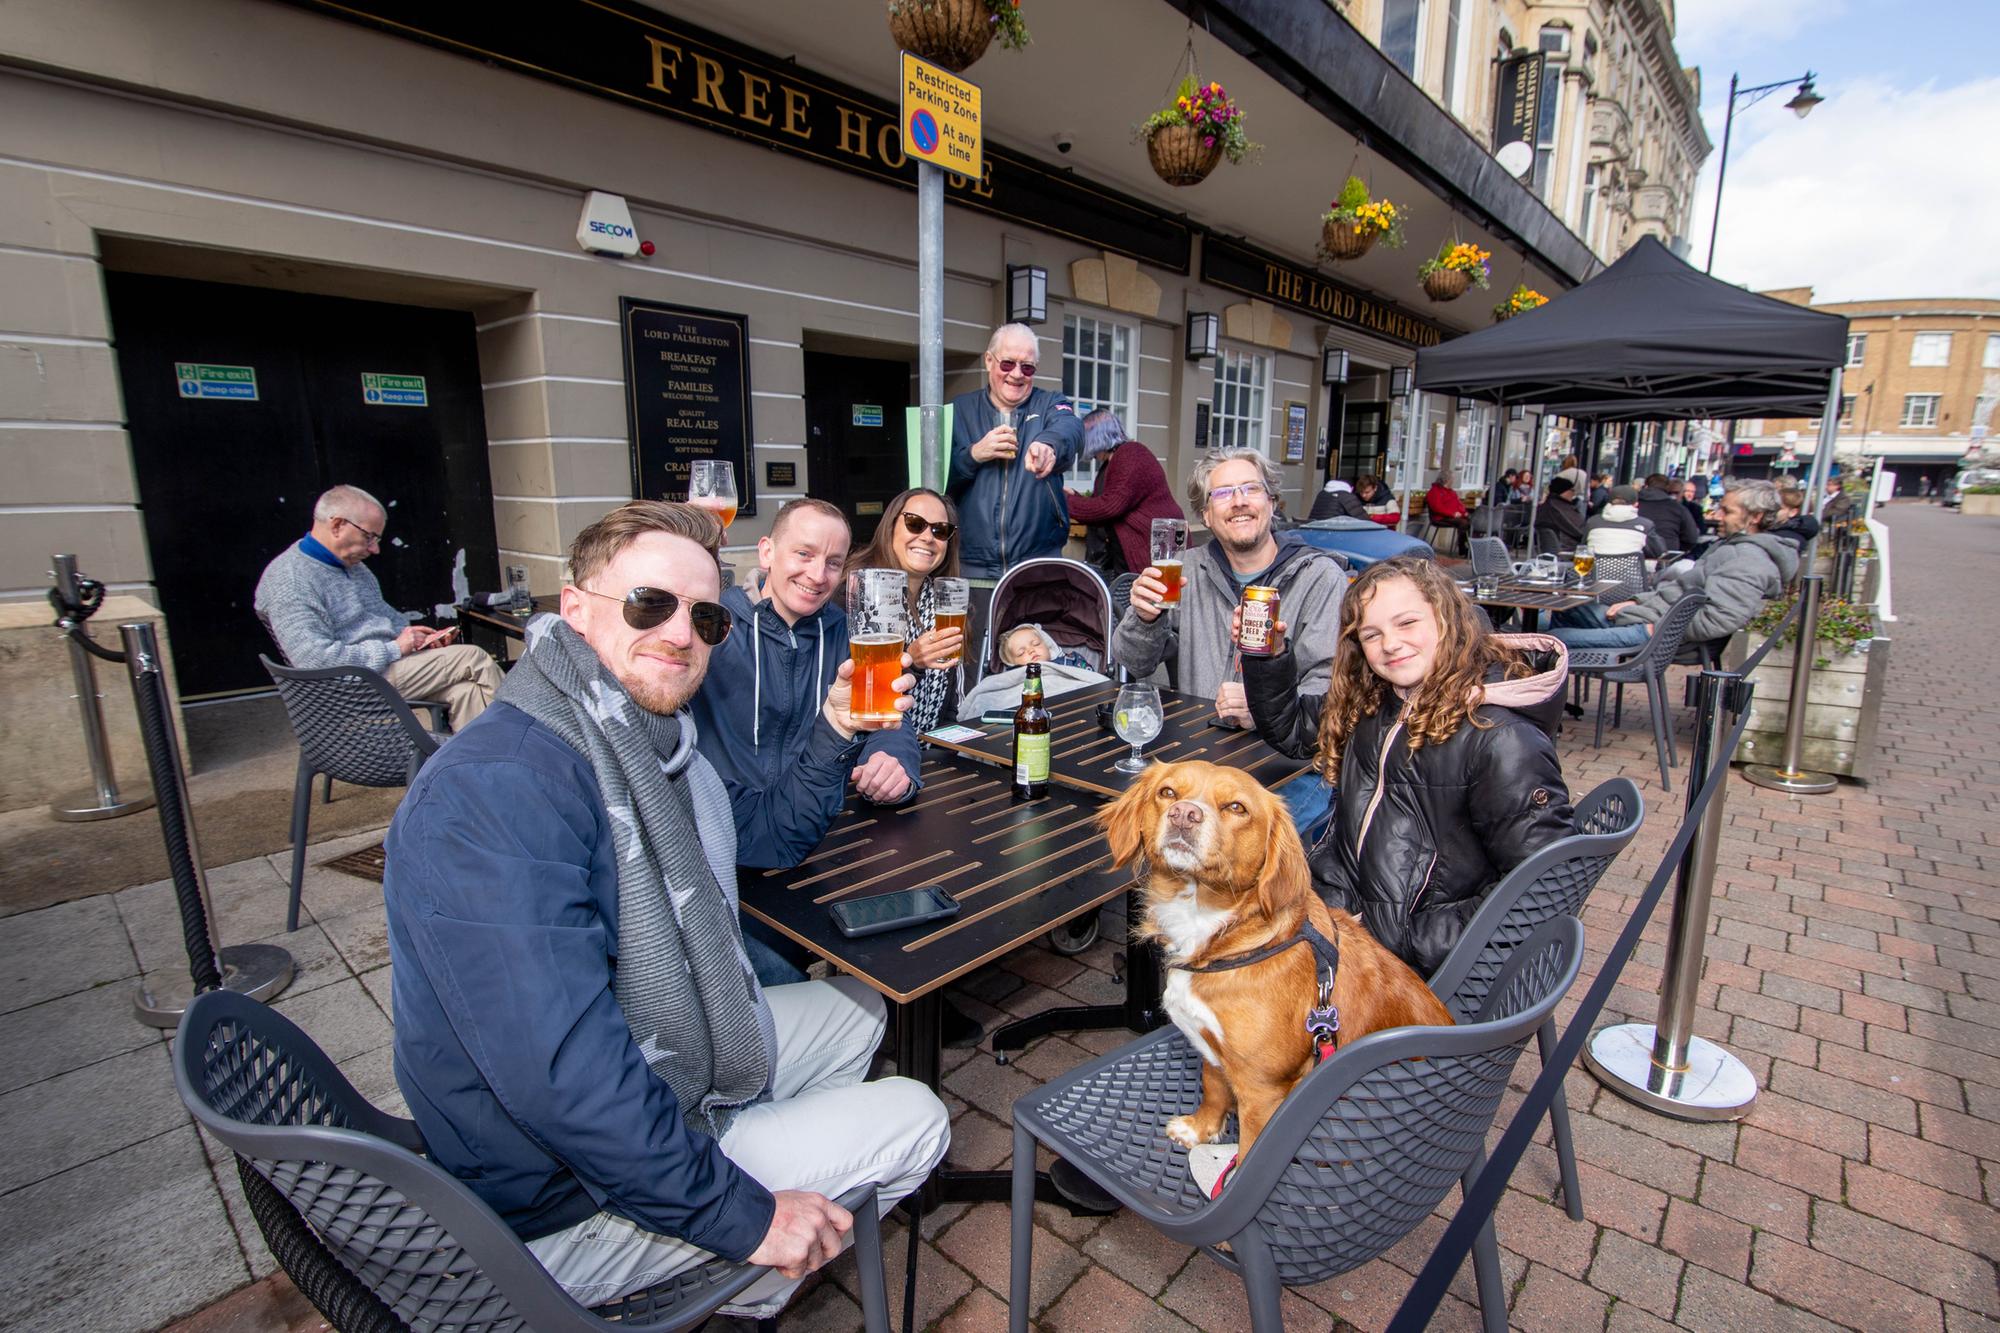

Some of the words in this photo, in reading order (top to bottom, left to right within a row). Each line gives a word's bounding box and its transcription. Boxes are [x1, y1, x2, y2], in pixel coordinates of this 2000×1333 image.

[916, 65, 971, 102] Restricted
[1515, 62, 1527, 98] LORD
[908, 81, 950, 112] Parking
[953, 101, 978, 122] Zone
[1522, 60, 1538, 142] PALMERSTON
[644, 34, 813, 140] FREE
[836, 104, 994, 199] HOE
[1513, 100, 1524, 126] THE
[943, 123, 955, 139] At
[958, 132, 976, 148] any
[948, 143, 971, 162] time
[589, 220, 633, 238] SECOM
[1265, 264, 1304, 303] THE
[1309, 280, 1355, 319] LORD
[1359, 301, 1441, 347] PALMERSTON
[678, 324, 698, 334] THE
[643, 329, 671, 340] LORD
[672, 333, 730, 347] PALMERSTON
[660, 351, 717, 366] BREAKFAST
[200, 368, 225, 379] Fire
[226, 370, 250, 380] exit
[690, 366, 709, 374] NOON
[381, 377, 401, 387] Fire
[402, 378, 422, 388] exit
[668, 380, 714, 393] FAMILIES
[202, 385, 228, 395] Keep
[662, 392, 694, 400] WELCOME
[678, 409, 706, 417] QUALITY
[666, 418, 693, 429] REAL
[695, 420, 719, 429] ALES
[668, 437, 688, 445] GOOD
[691, 446, 714, 454] DRINKS
[1244, 619, 1264, 628] GINGER
[1246, 627, 1260, 635] BEER
